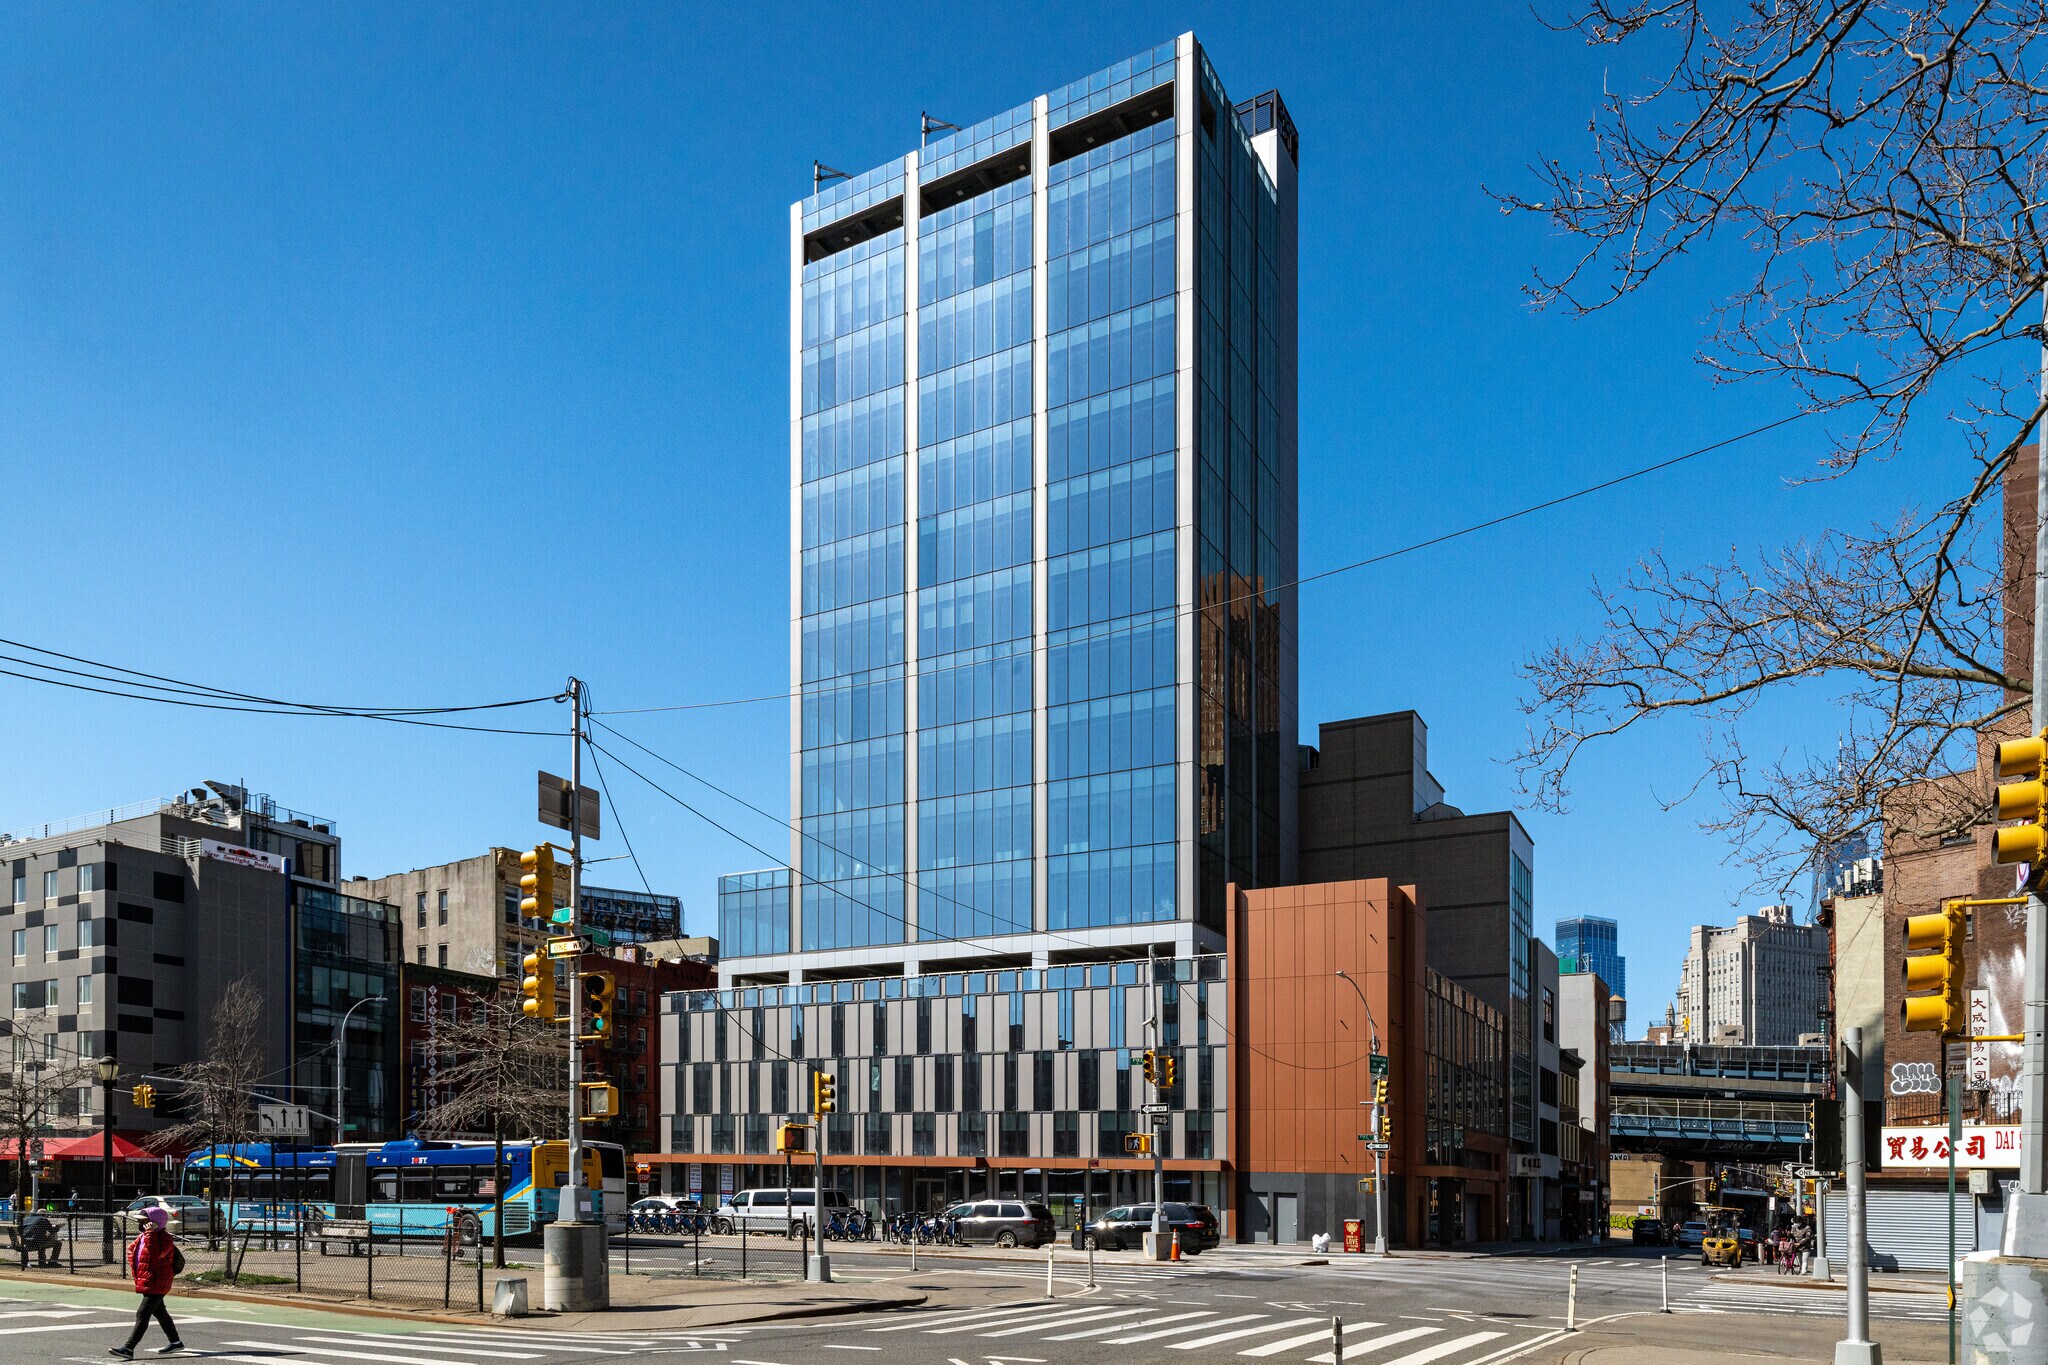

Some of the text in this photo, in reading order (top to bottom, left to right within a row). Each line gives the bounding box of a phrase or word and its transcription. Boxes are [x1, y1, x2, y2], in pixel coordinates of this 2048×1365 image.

[204, 850, 220, 858] New
[223, 854, 250, 865] Sunlight
[254, 861, 280, 872] Building
[553, 940, 587, 951] ONE WAY
[1886, 1135, 1986, 1161] 貿易公司
[1995, 1131, 2015, 1149] DAI
